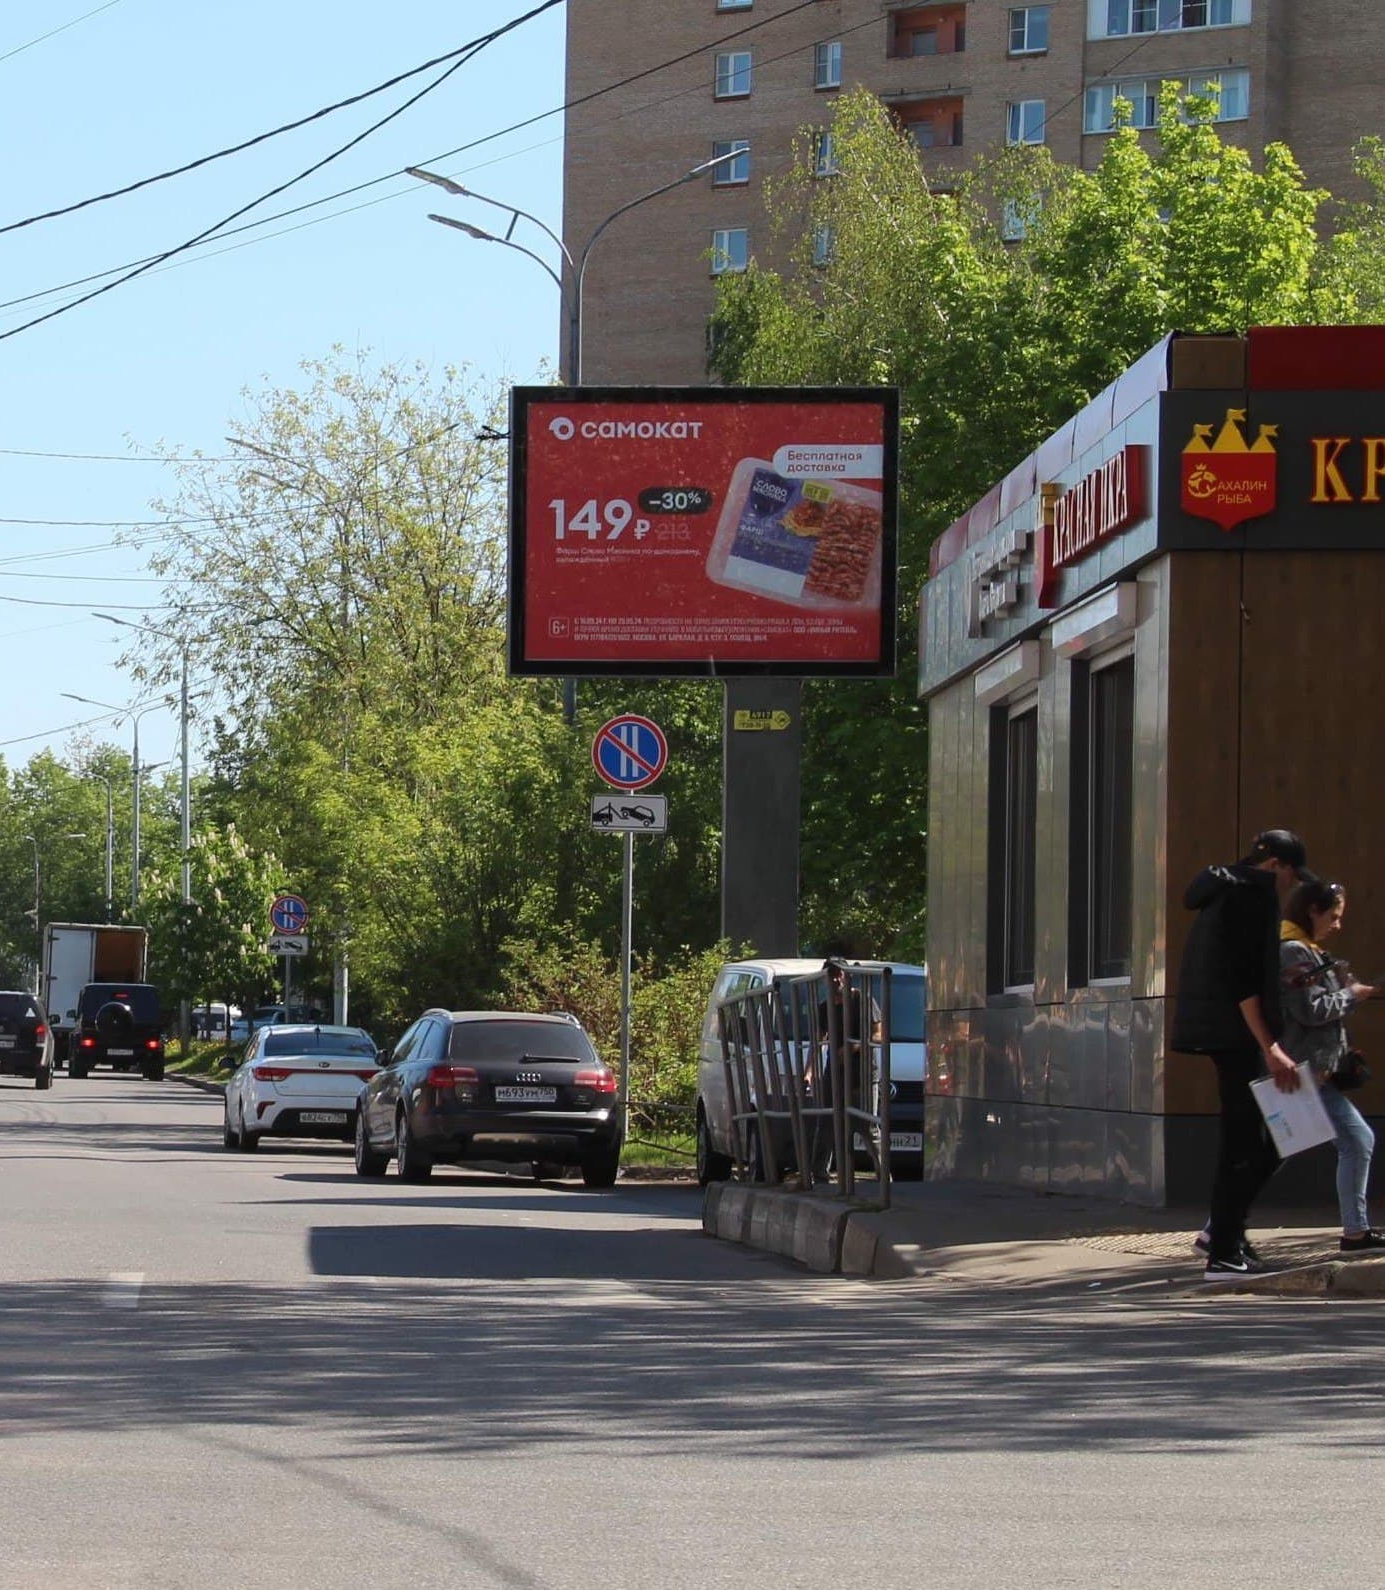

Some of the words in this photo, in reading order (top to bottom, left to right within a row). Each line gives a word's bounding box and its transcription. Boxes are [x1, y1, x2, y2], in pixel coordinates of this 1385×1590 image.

[580, 421, 703, 439] самокат
[787, 450, 862, 461] Бесплатная
[786, 463, 846, 473] доставка
[649, 492, 702, 510] -30%
[1217, 494, 1253, 505] РЫБА
[1052, 471, 1096, 568] КРАСНАЯ
[1099, 448, 1128, 536] ИКРА
[552, 620, 566, 634] 6+
